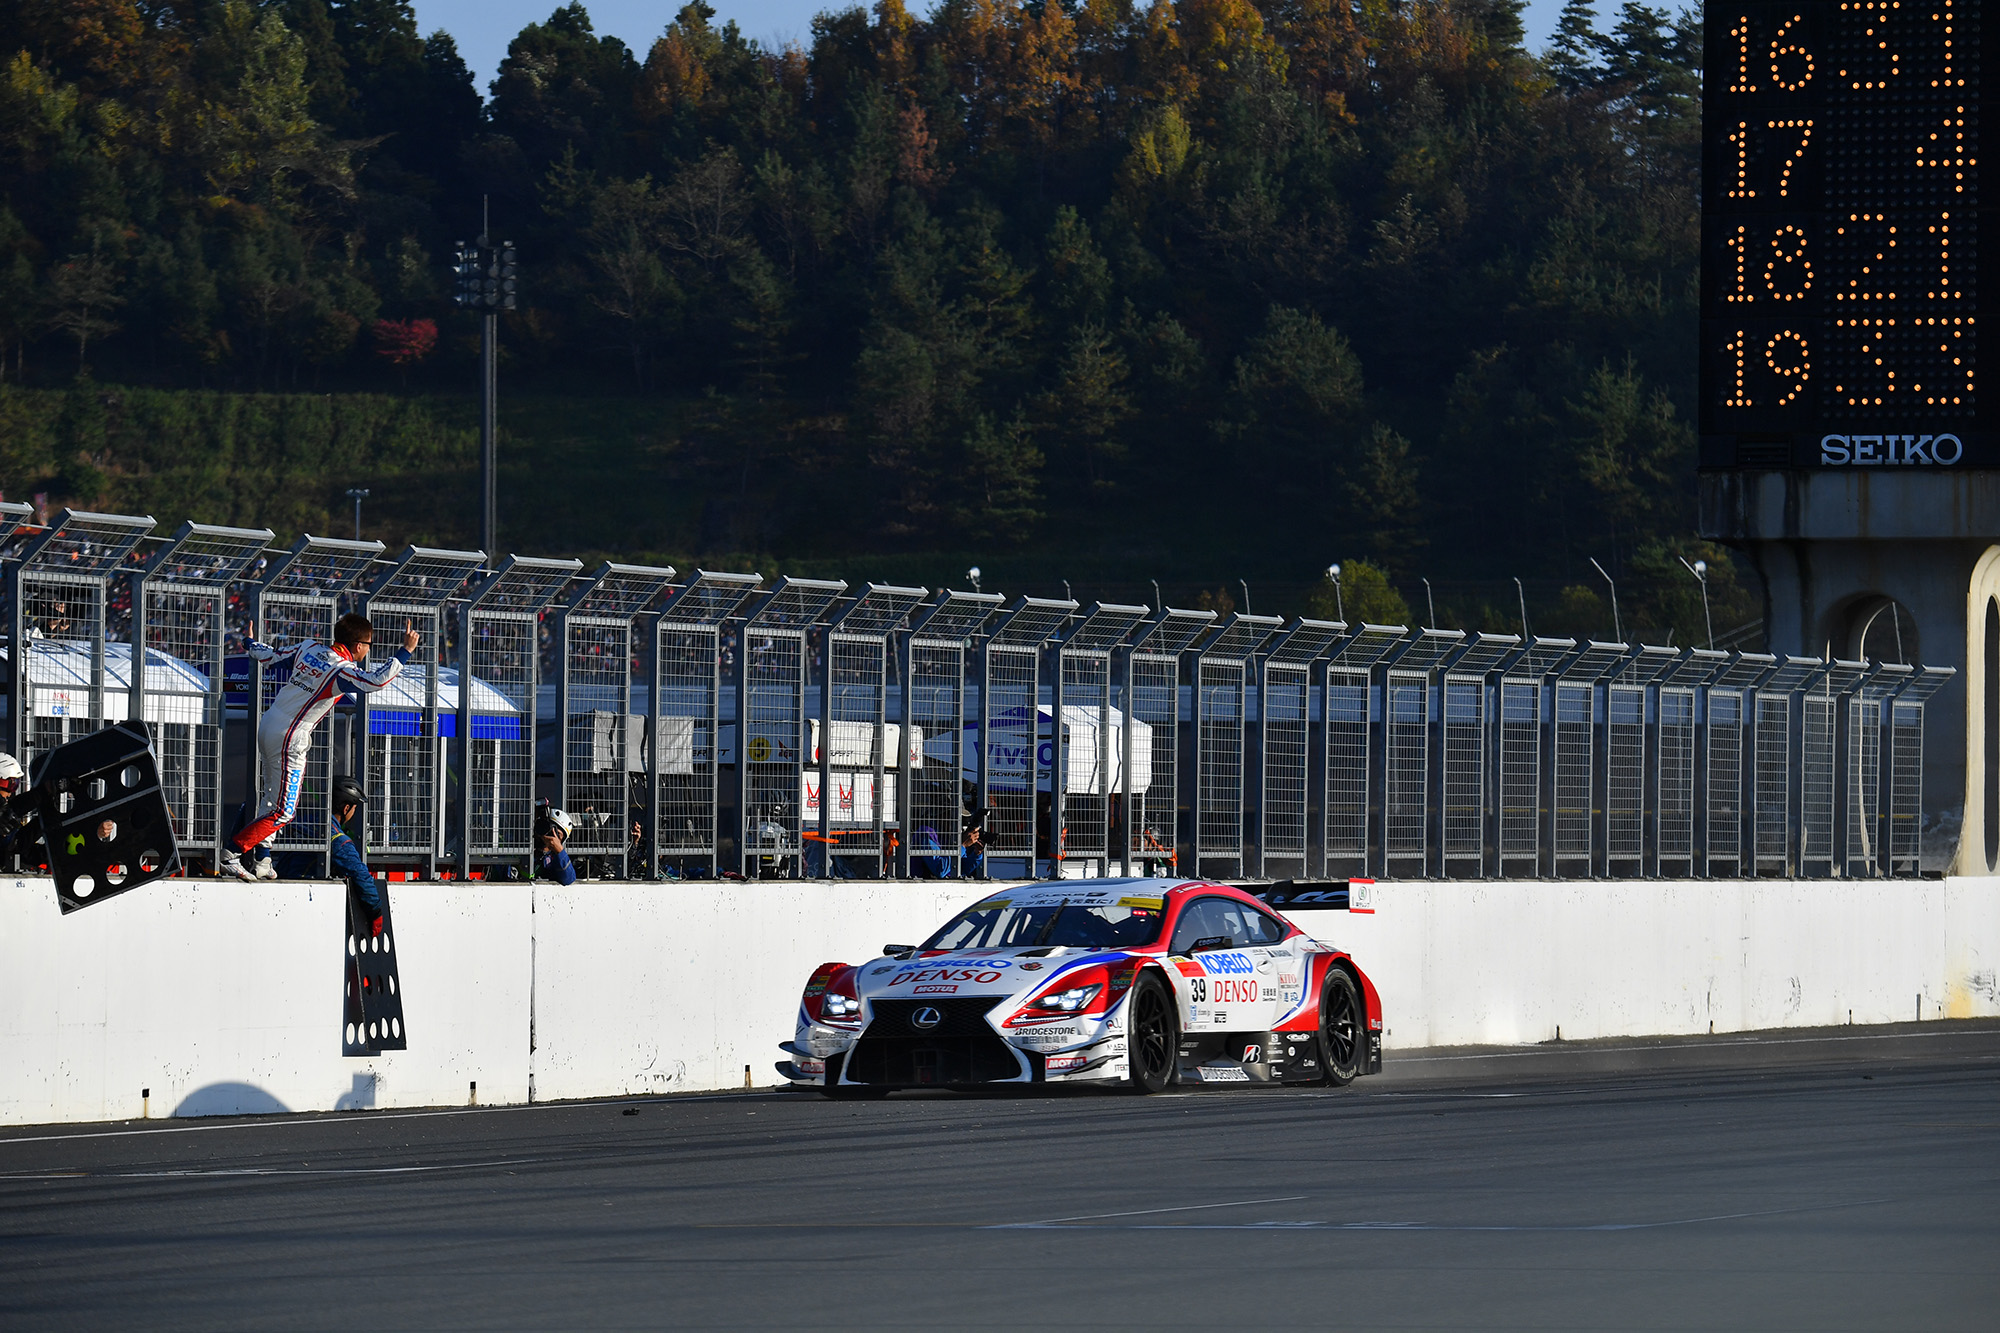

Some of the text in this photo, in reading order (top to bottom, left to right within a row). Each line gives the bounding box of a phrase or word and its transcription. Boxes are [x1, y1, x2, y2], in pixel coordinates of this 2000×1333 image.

[1729, 14, 1815, 92] 16
[1728, 106, 1977, 198] 17 4
[1727, 211, 1962, 302] 18 21
[1726, 317, 1976, 407] 19 33
[1820, 433, 1963, 466] SEIKO
[898, 959, 1012, 972] KOBELCO
[1196, 953, 1253, 974] KOBELCO
[888, 969, 1002, 987] DENSO
[916, 985, 956, 993] MOTUL
[1191, 978, 1206, 1003] 39
[1214, 980, 1258, 1003] DENSO
[1015, 1027, 1076, 1036] BRIDGESTONE
[1048, 1058, 1084, 1068] MOTUL
